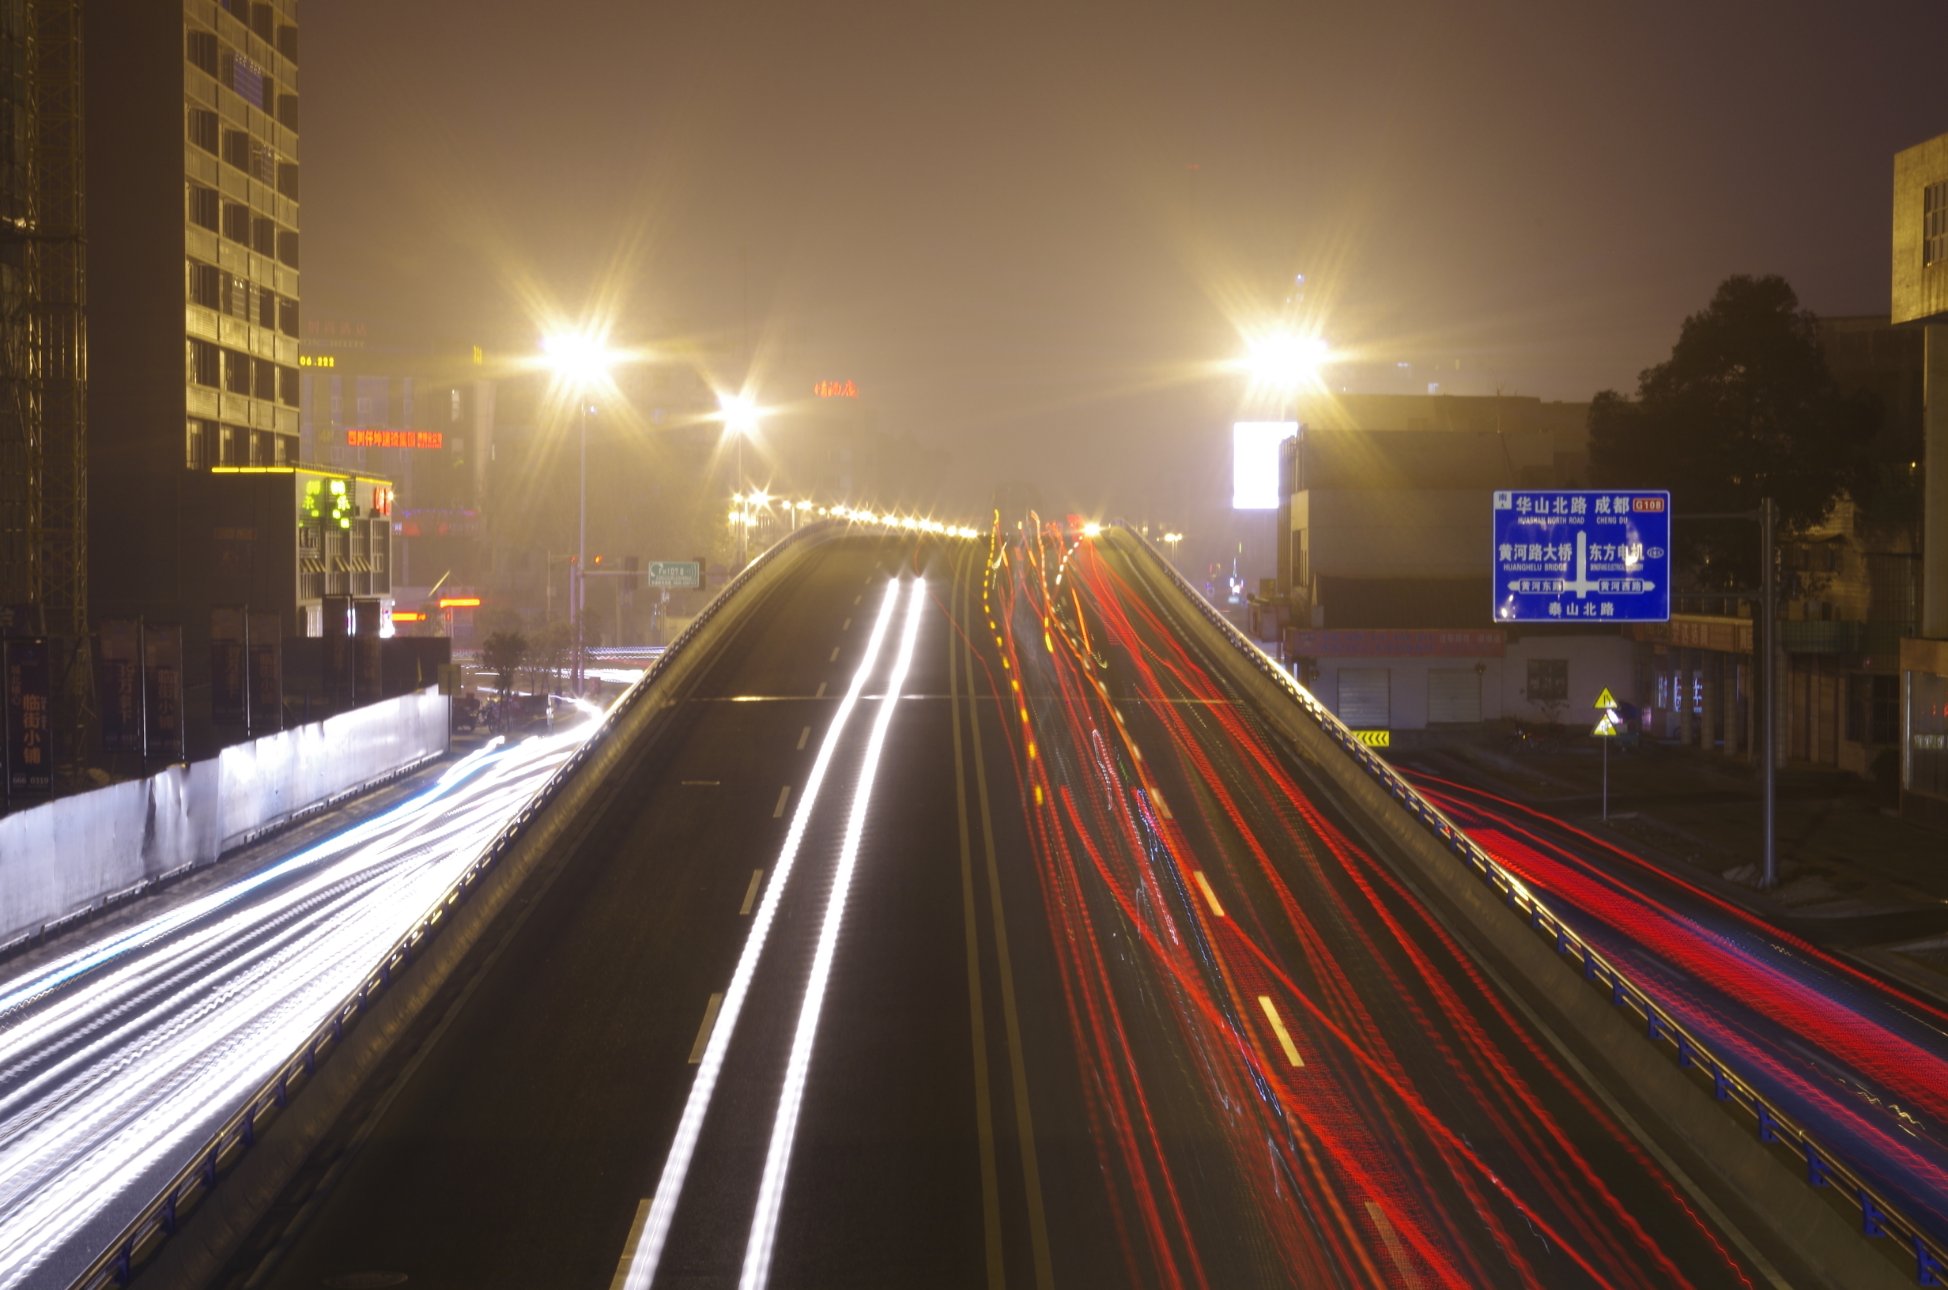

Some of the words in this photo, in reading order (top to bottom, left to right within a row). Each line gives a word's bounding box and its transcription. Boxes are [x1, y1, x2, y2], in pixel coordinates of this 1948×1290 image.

[1516, 497, 1587, 515] 华山北路
[1595, 496, 1630, 515] 成都
[1636, 501, 1662, 510] G108
[1548, 516, 1567, 525] NORTH
[1569, 516, 1585, 525] ROAD
[1596, 516, 1616, 525] CHENG
[1619, 516, 1628, 525] DU
[1499, 543, 1573, 561] 黄河路大桥
[1589, 542, 1645, 561] 东方电机
[1503, 563, 1542, 572] HUANGHELU
[1544, 563, 1568, 572] BRIDGE
[1521, 581, 1563, 591] 黄河东路
[1549, 601, 1614, 616] 泰山北路
[22, 693, 41, 765] 临街小铺
